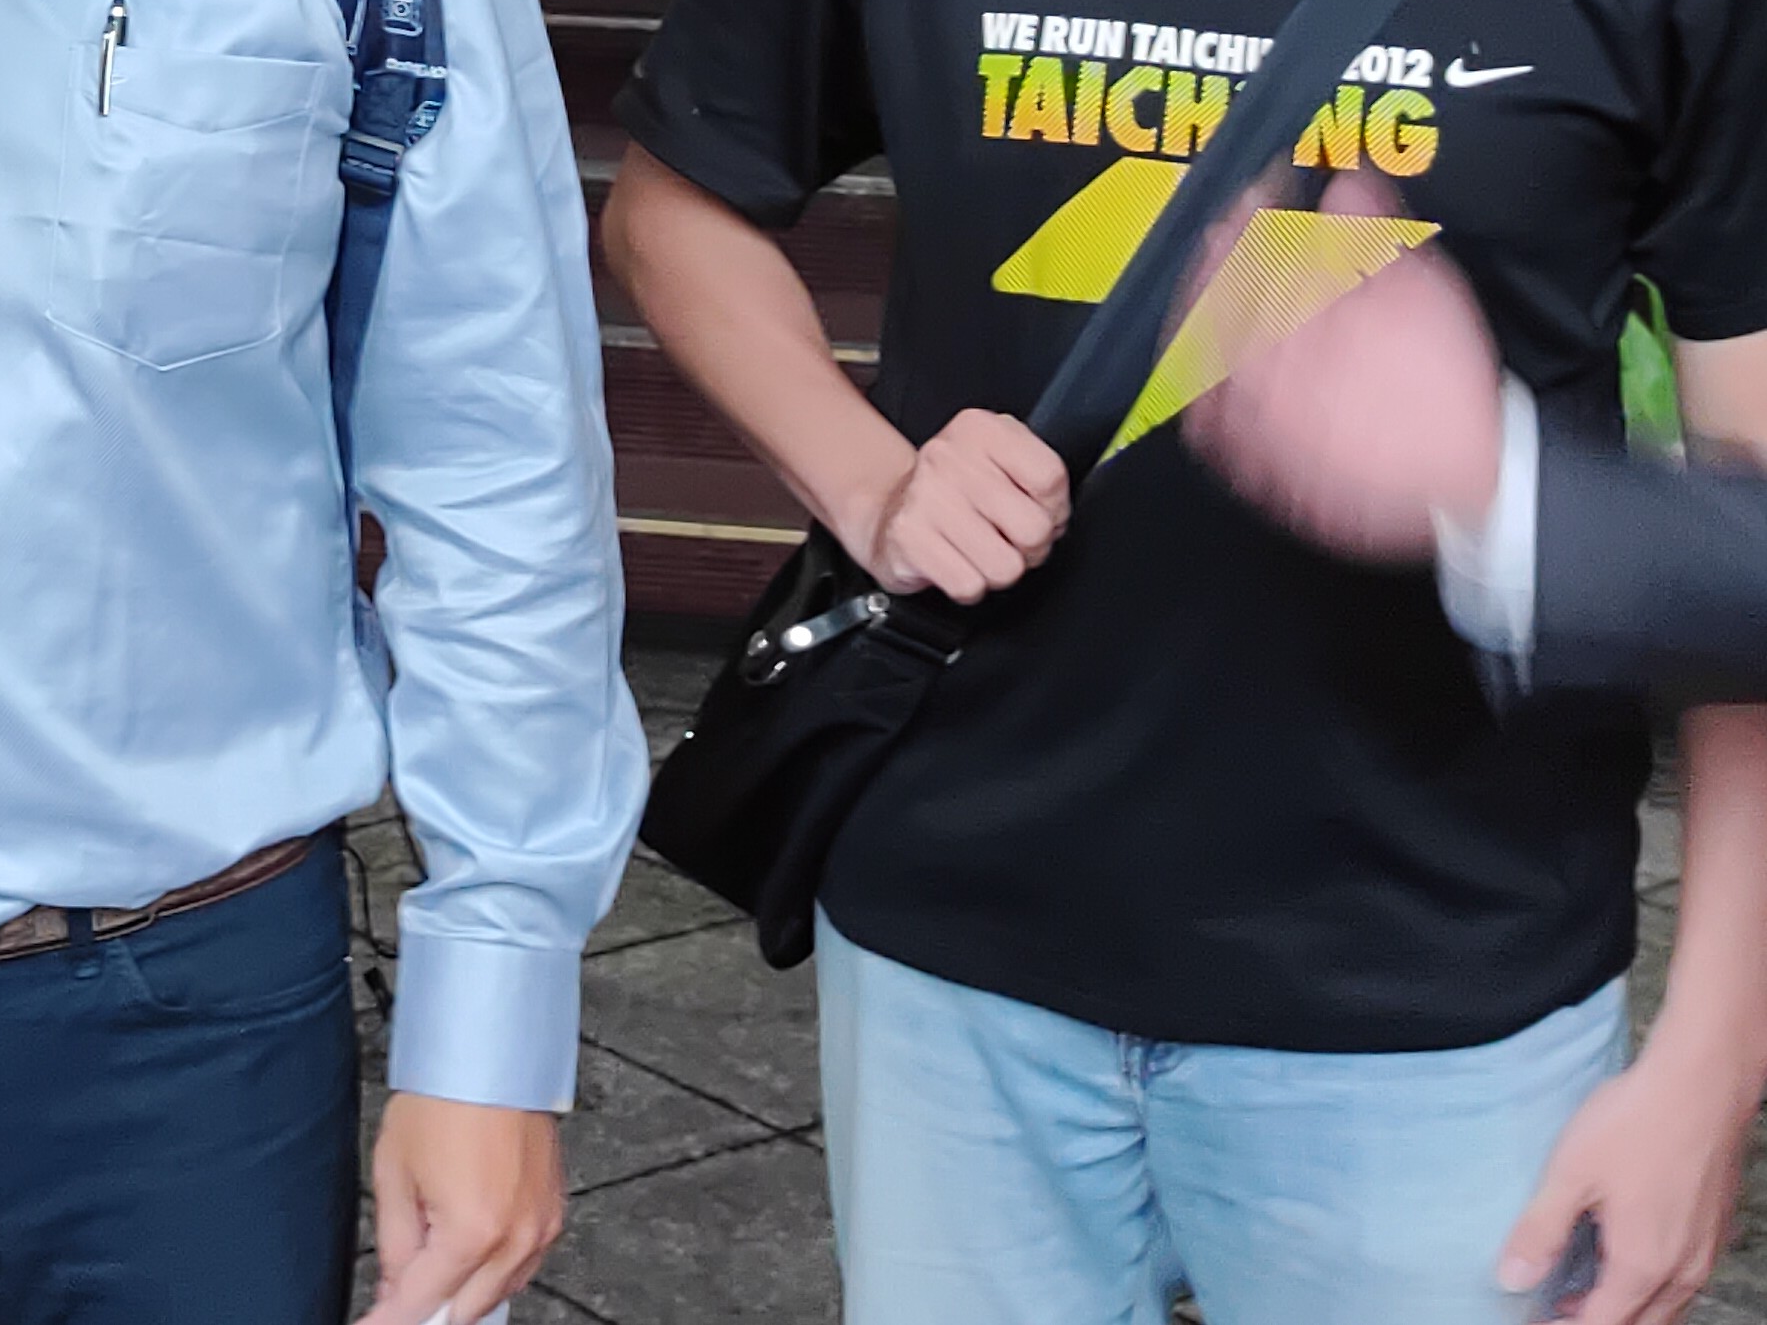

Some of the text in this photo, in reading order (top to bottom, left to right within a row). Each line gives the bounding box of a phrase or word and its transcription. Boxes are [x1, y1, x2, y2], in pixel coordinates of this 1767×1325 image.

[981, 11, 1038, 52] WE
[1040, 16, 1125, 59] RUN
[977, 53, 1440, 177] TAICHNG
